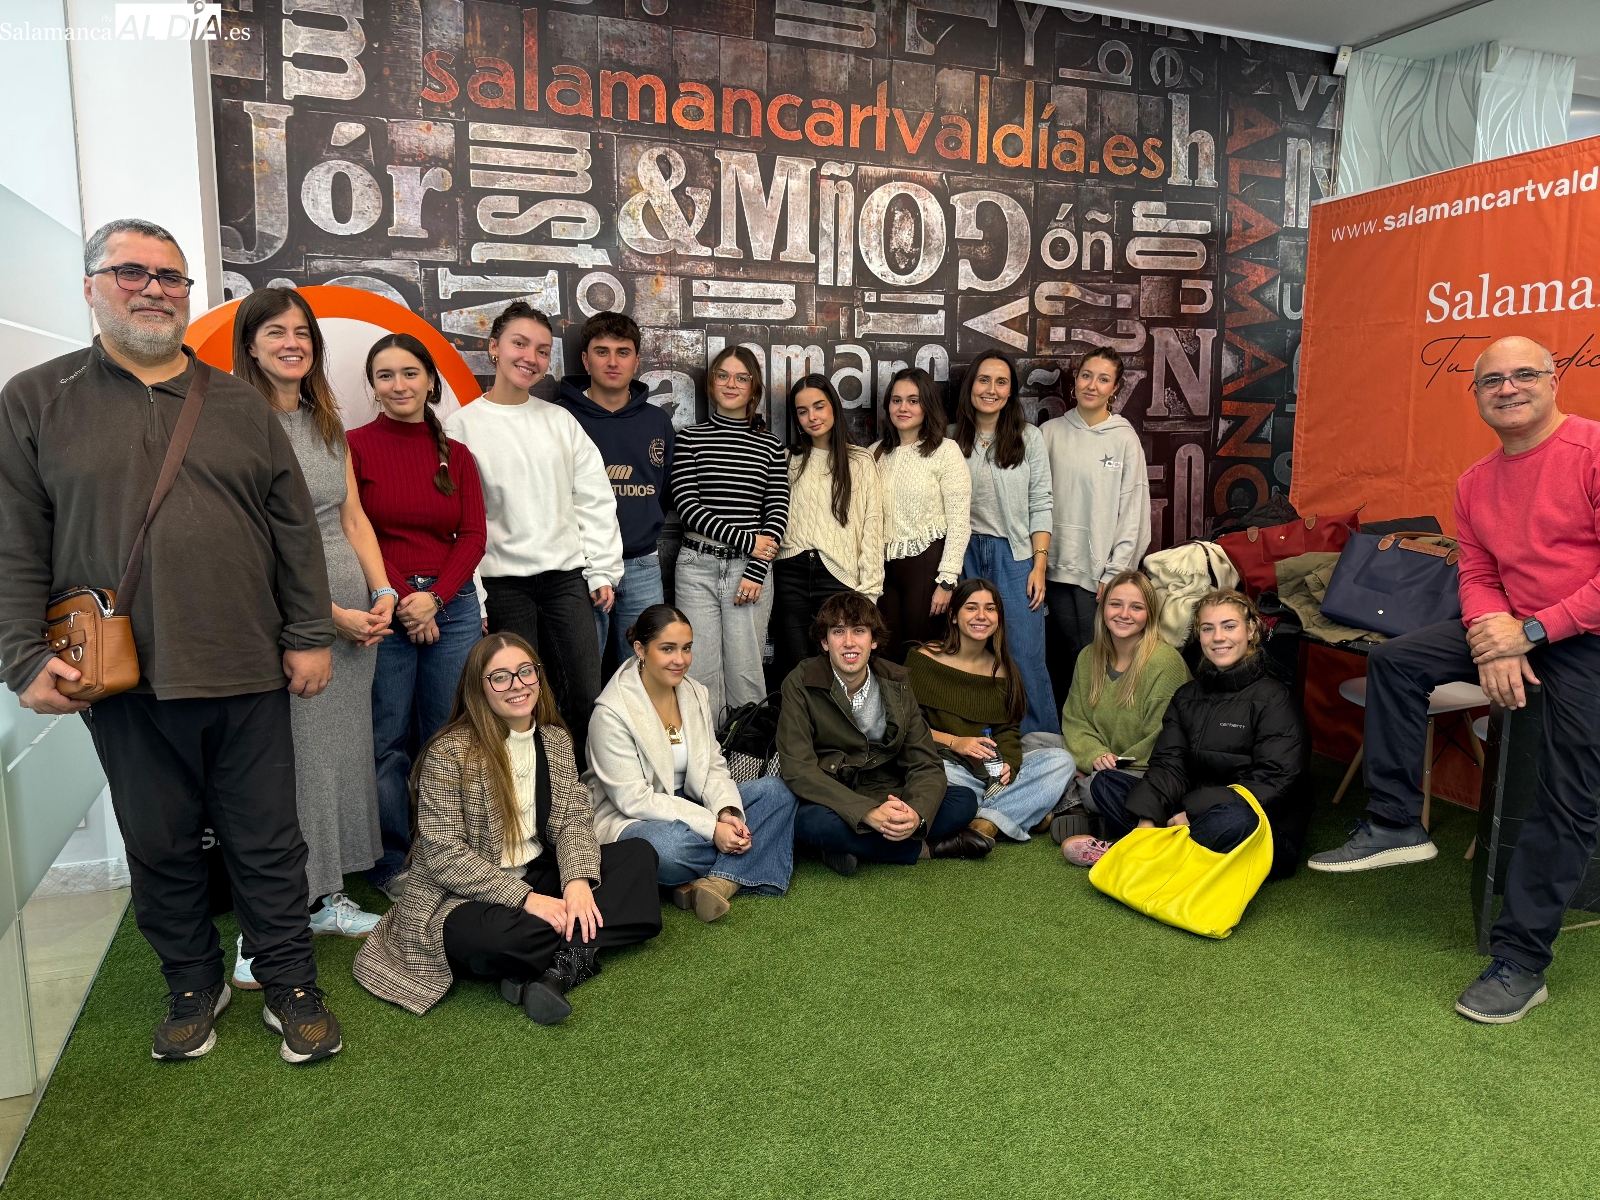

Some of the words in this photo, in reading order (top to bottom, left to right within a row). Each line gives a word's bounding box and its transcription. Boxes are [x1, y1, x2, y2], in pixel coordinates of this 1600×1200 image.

[421, 8, 1165, 179] salamancartvaldía.es
[1331, 166, 1600, 242] www.salamancartvald
[1425, 273, 1600, 324] Salama
[611, 484, 656, 497] TUDIOS
